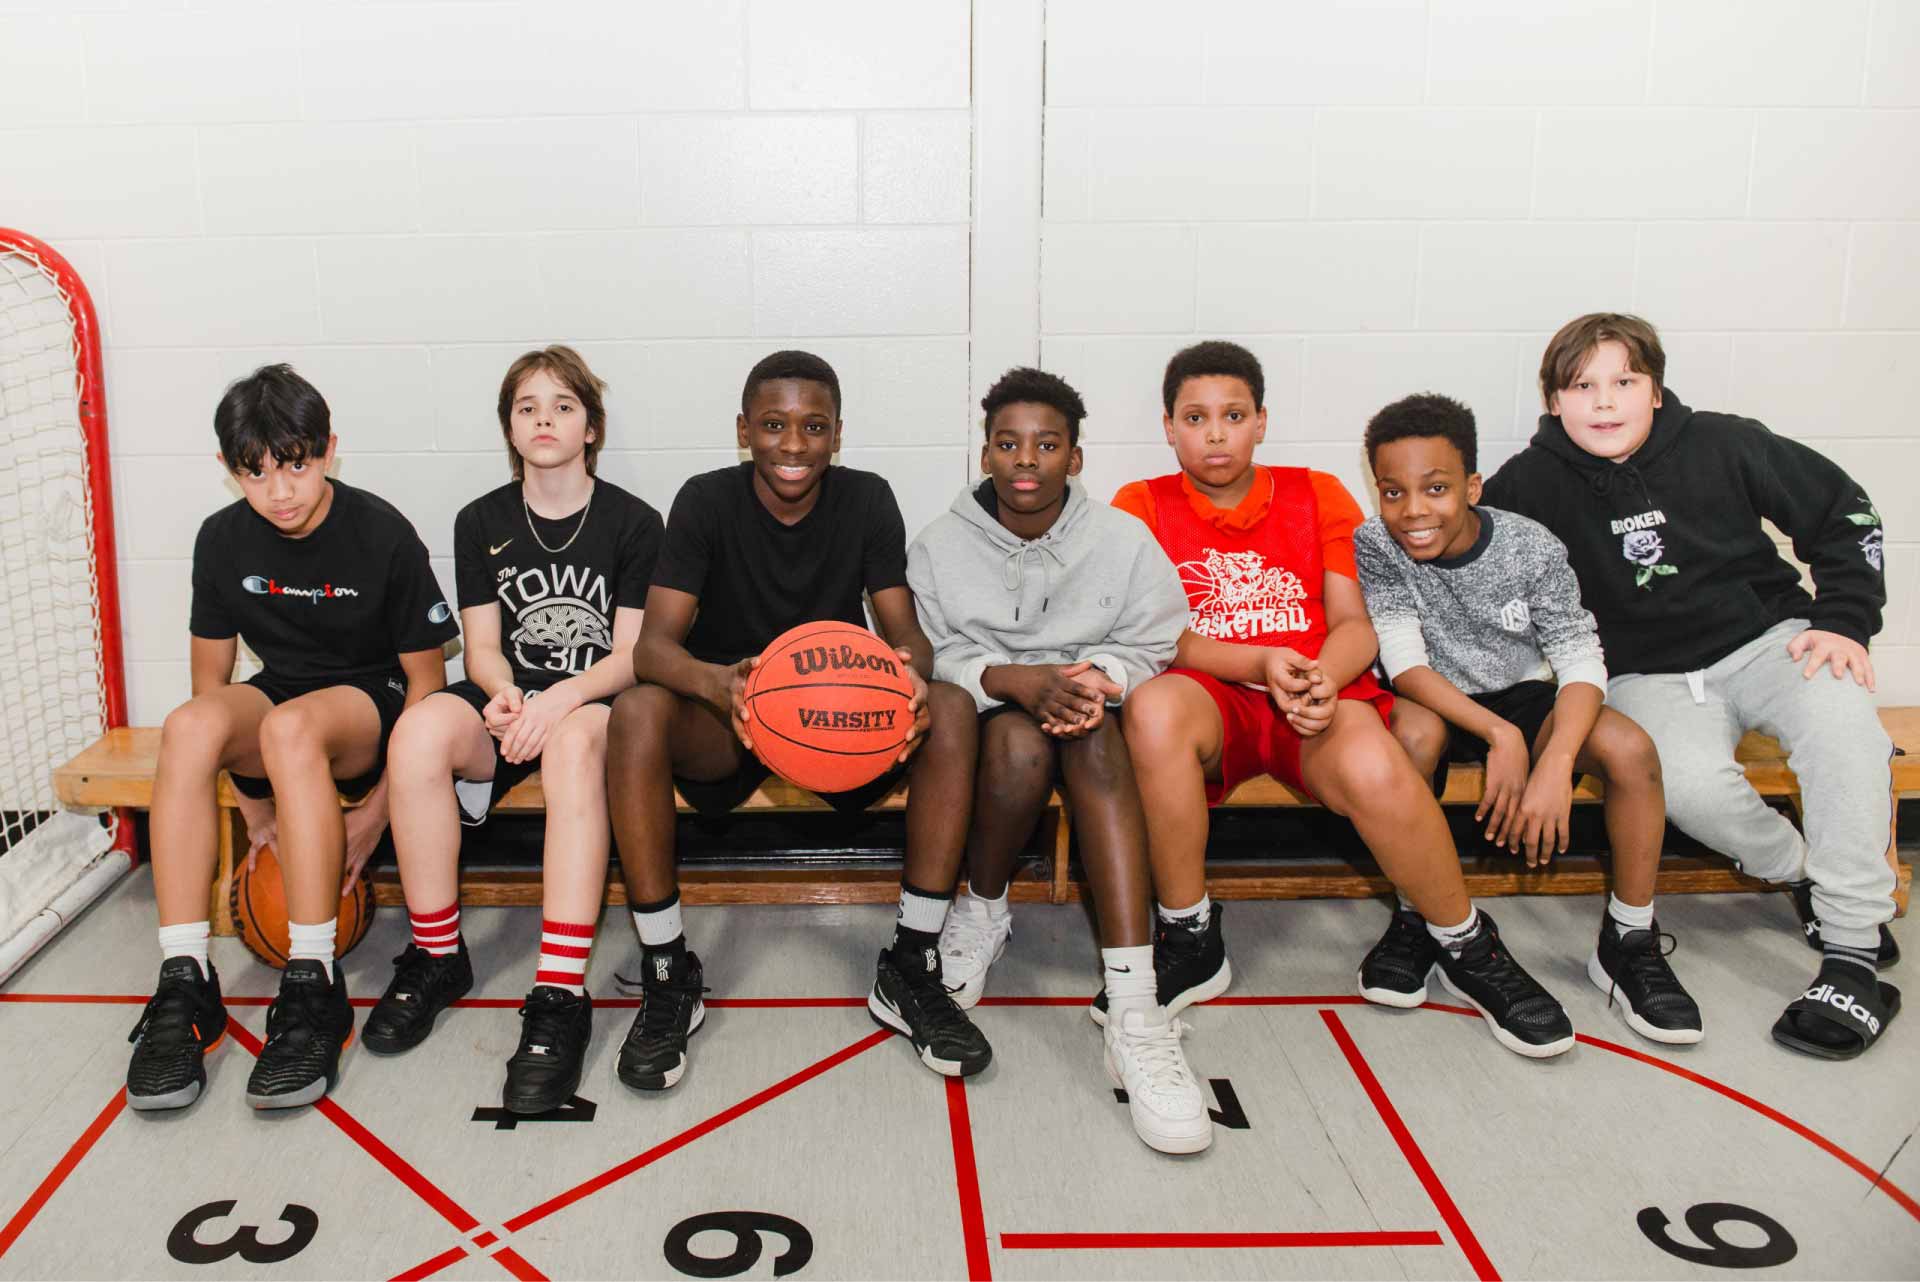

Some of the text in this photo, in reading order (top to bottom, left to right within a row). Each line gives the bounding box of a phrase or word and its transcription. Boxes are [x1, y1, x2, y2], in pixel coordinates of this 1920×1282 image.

[1611, 510, 1667, 535] BROKEN
[497, 566, 518, 582] The
[498, 563, 613, 614] TOWN
[242, 575, 359, 605] Champion
[790, 645, 900, 678] Wilson
[798, 708, 897, 729] VARSITY
[166, 1199, 319, 1265] 3
